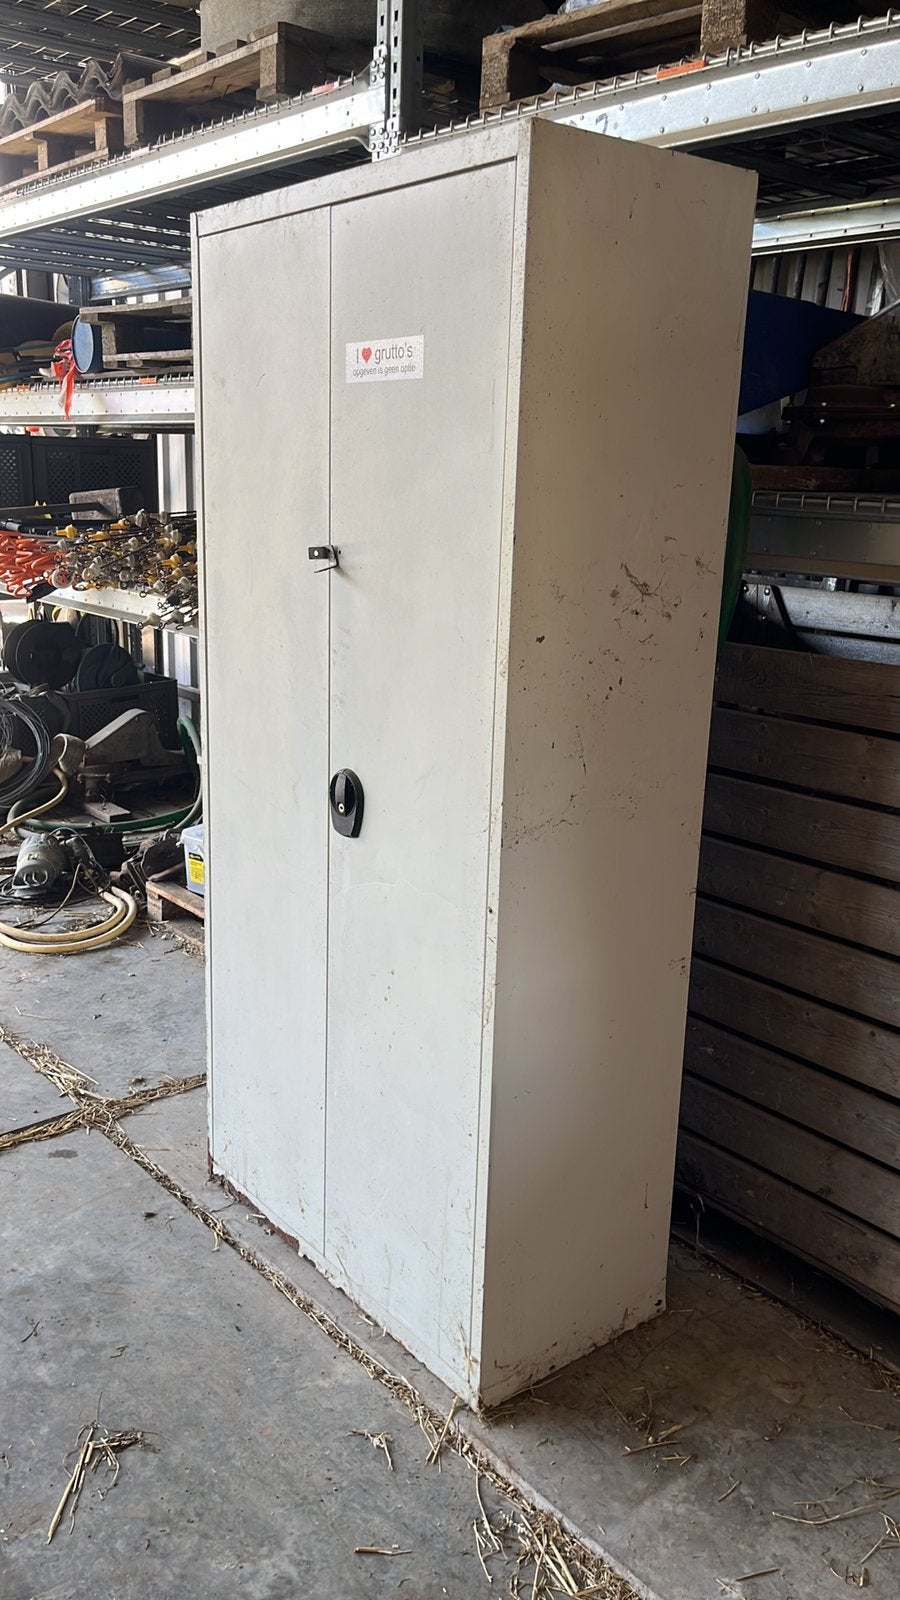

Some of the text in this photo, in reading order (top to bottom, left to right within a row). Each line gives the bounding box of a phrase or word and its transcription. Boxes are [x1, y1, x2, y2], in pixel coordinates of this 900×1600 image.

[375, 342, 413, 364] grutto's
[353, 367, 377, 378] opgeven
[385, 365, 399, 376] geen
[401, 363, 416, 374] optie
